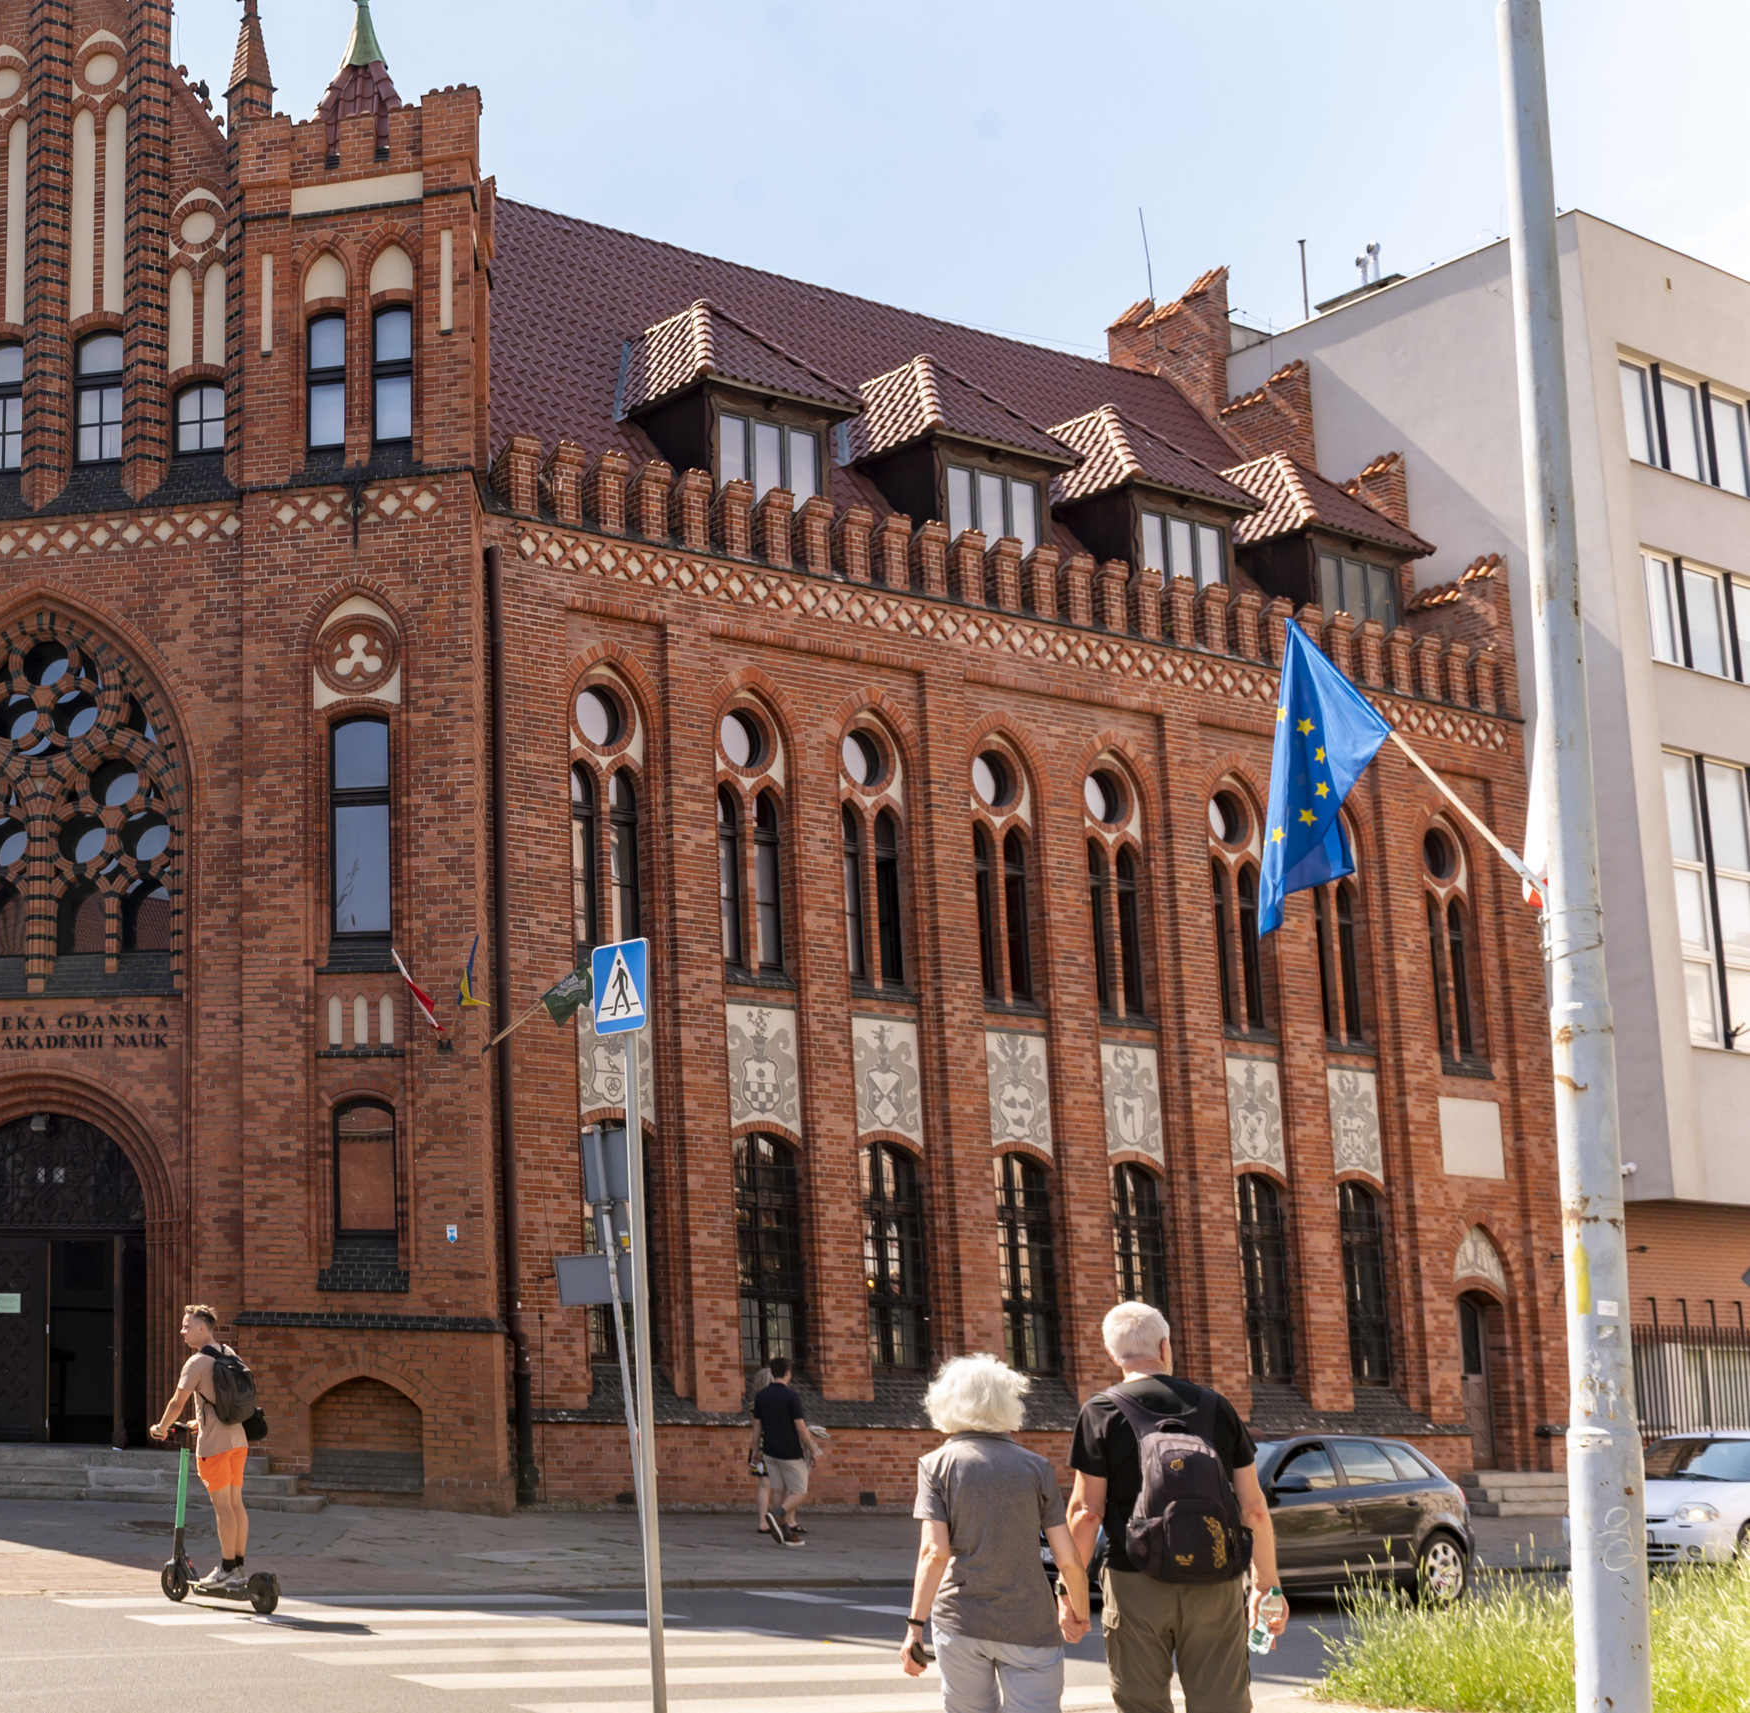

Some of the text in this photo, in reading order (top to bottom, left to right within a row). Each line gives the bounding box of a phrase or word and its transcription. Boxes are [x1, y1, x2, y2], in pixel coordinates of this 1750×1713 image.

[57, 1012, 169, 1029] GDAŃSKA
[1, 1033, 103, 1050] AKADEMII
[113, 1032, 169, 1049] NAUK
